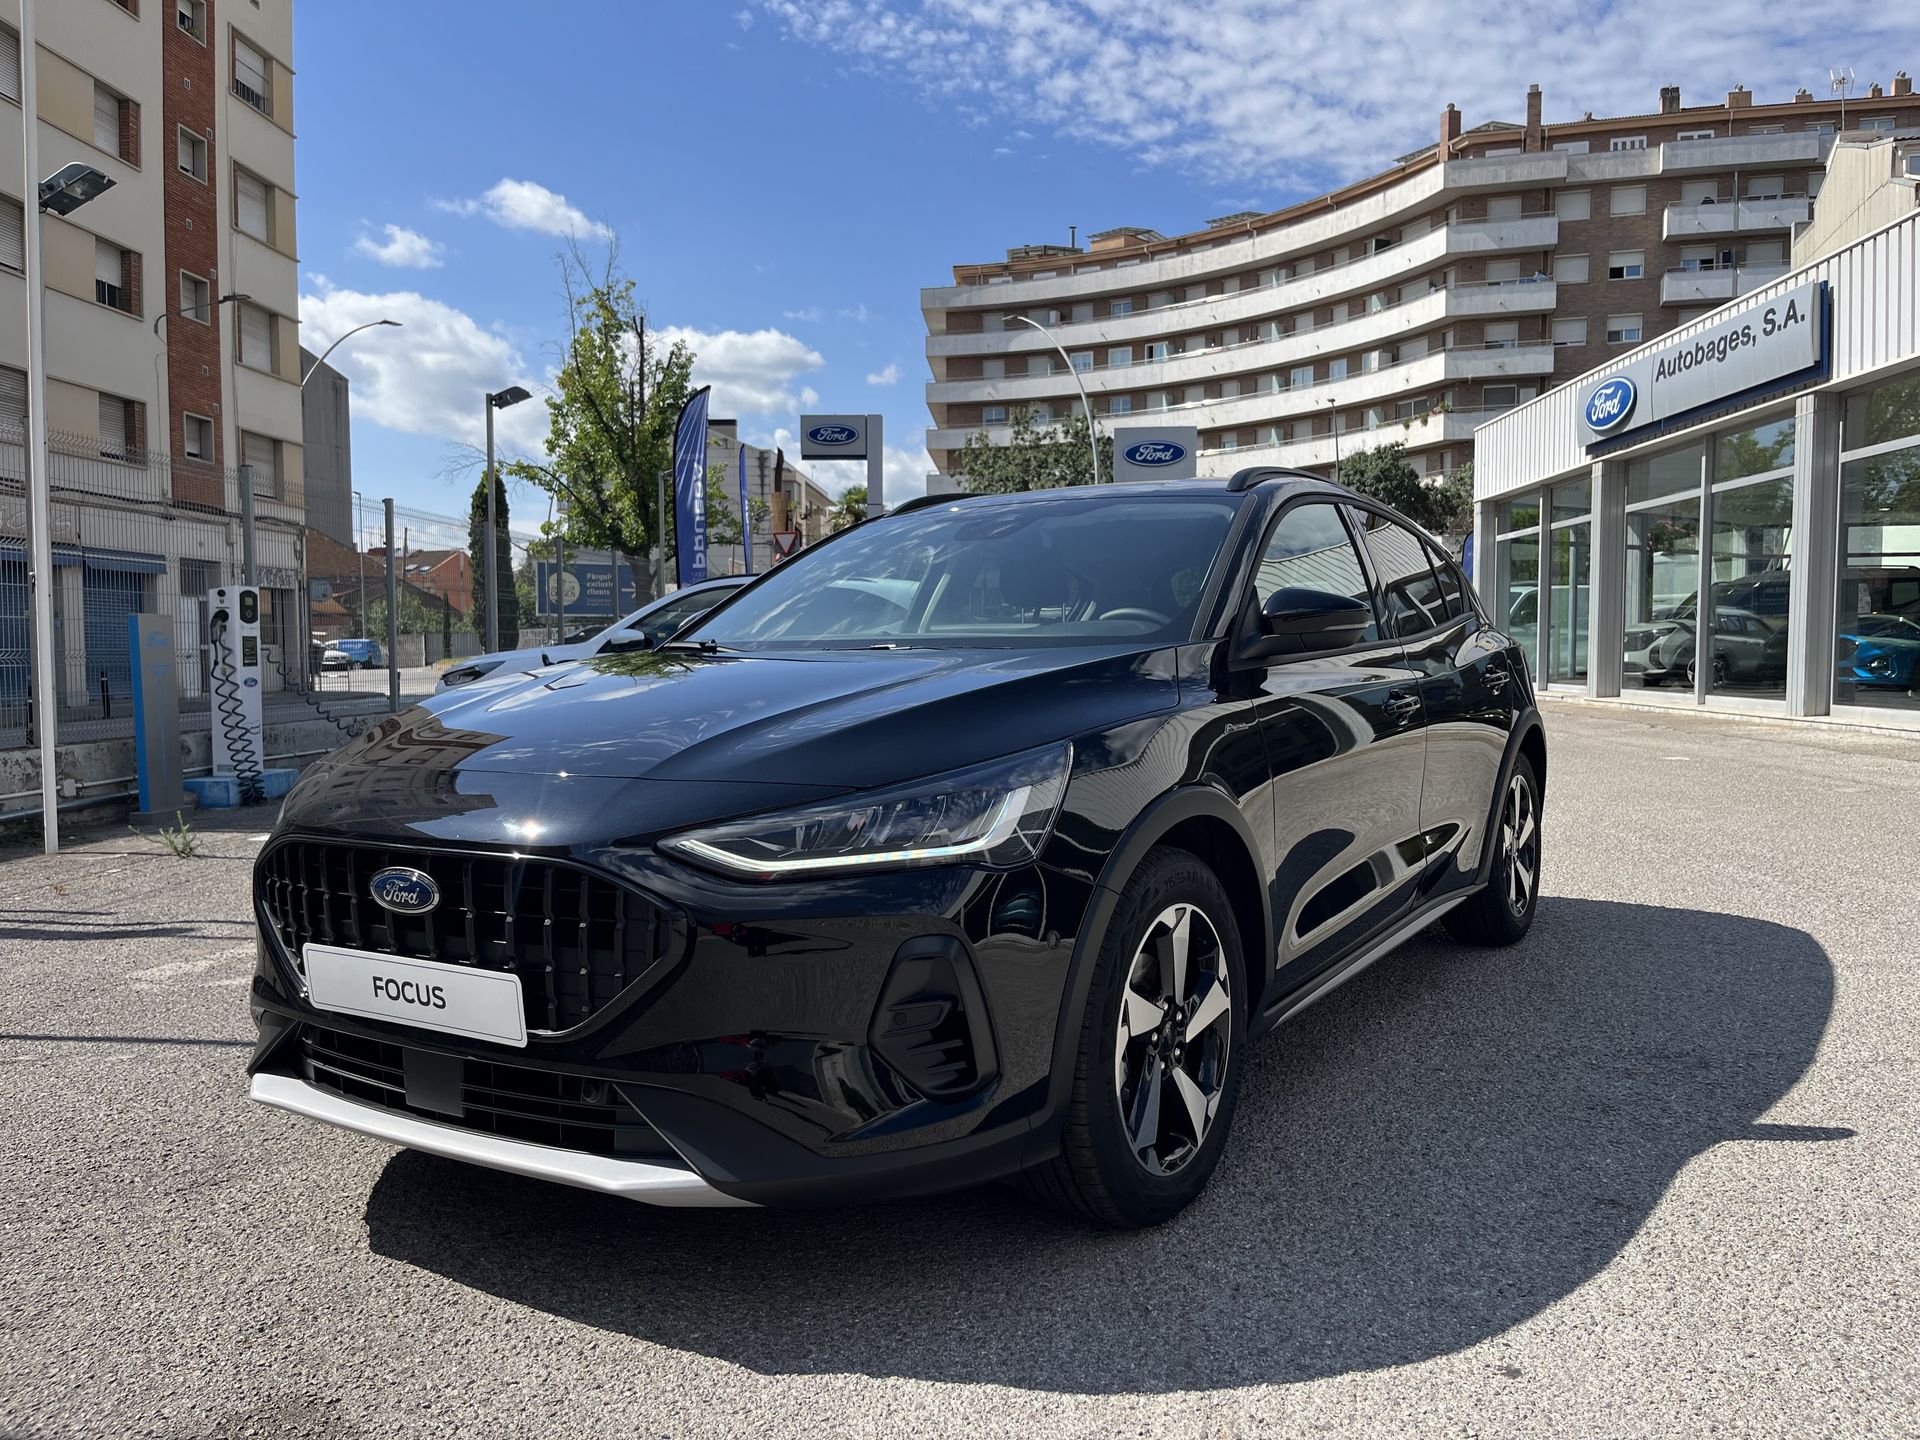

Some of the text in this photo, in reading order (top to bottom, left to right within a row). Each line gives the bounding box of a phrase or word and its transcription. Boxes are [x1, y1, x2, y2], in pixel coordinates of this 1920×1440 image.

[1655, 298, 1806, 382] Autobages, S.A.
[1591, 387, 1620, 421] Ford
[816, 427, 849, 441] Ford
[1135, 444, 1174, 461] Ford
[587, 588, 610, 596] clients
[383, 880, 420, 904] Ford
[373, 976, 446, 1009] FOCUS
